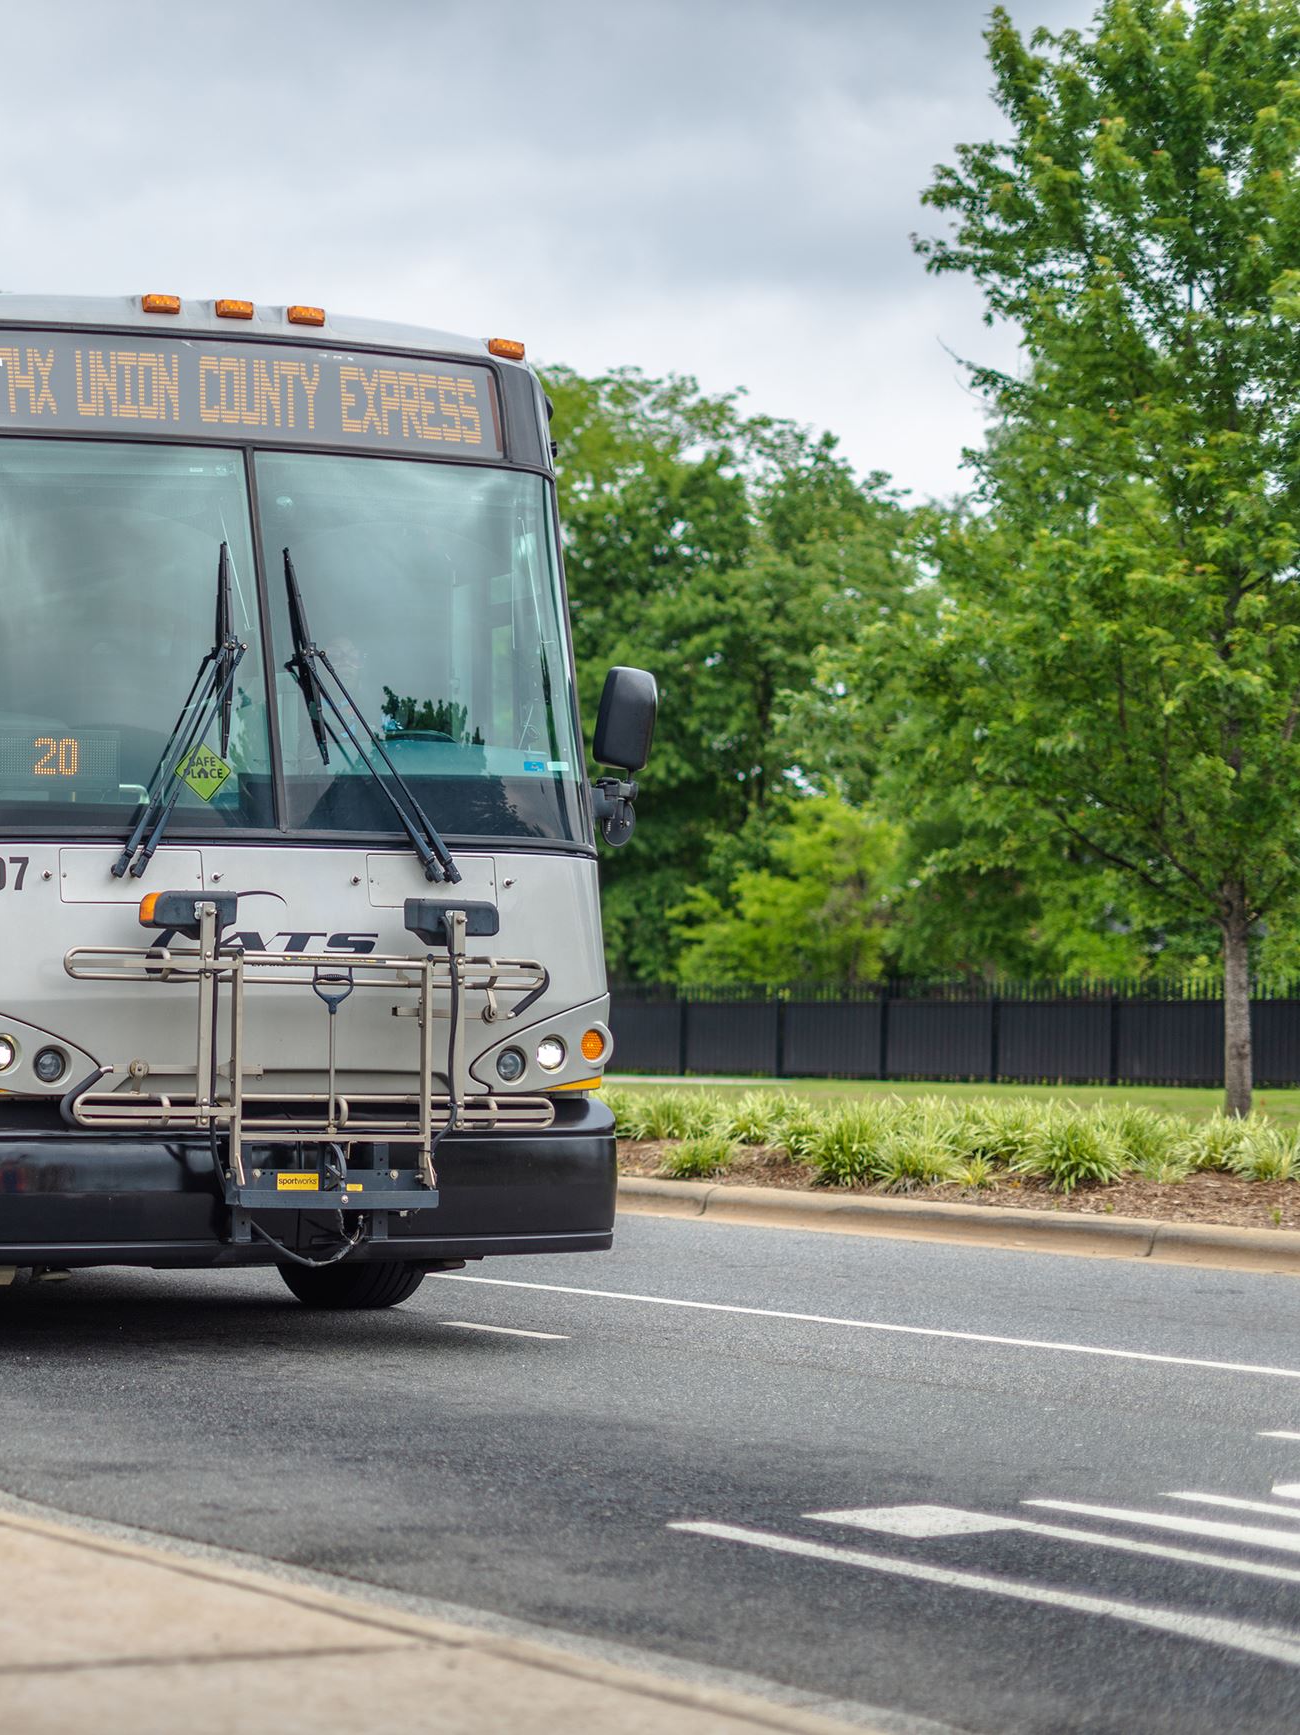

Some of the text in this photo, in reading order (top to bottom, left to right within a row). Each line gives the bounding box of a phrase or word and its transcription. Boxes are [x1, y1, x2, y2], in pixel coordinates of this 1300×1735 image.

[75, 350, 180, 421] UNION
[199, 355, 320, 430] COUNTY
[339, 365, 483, 444] EXPRESS
[33, 737, 79, 776] 20
[278, 1177, 317, 1186] sportworks
